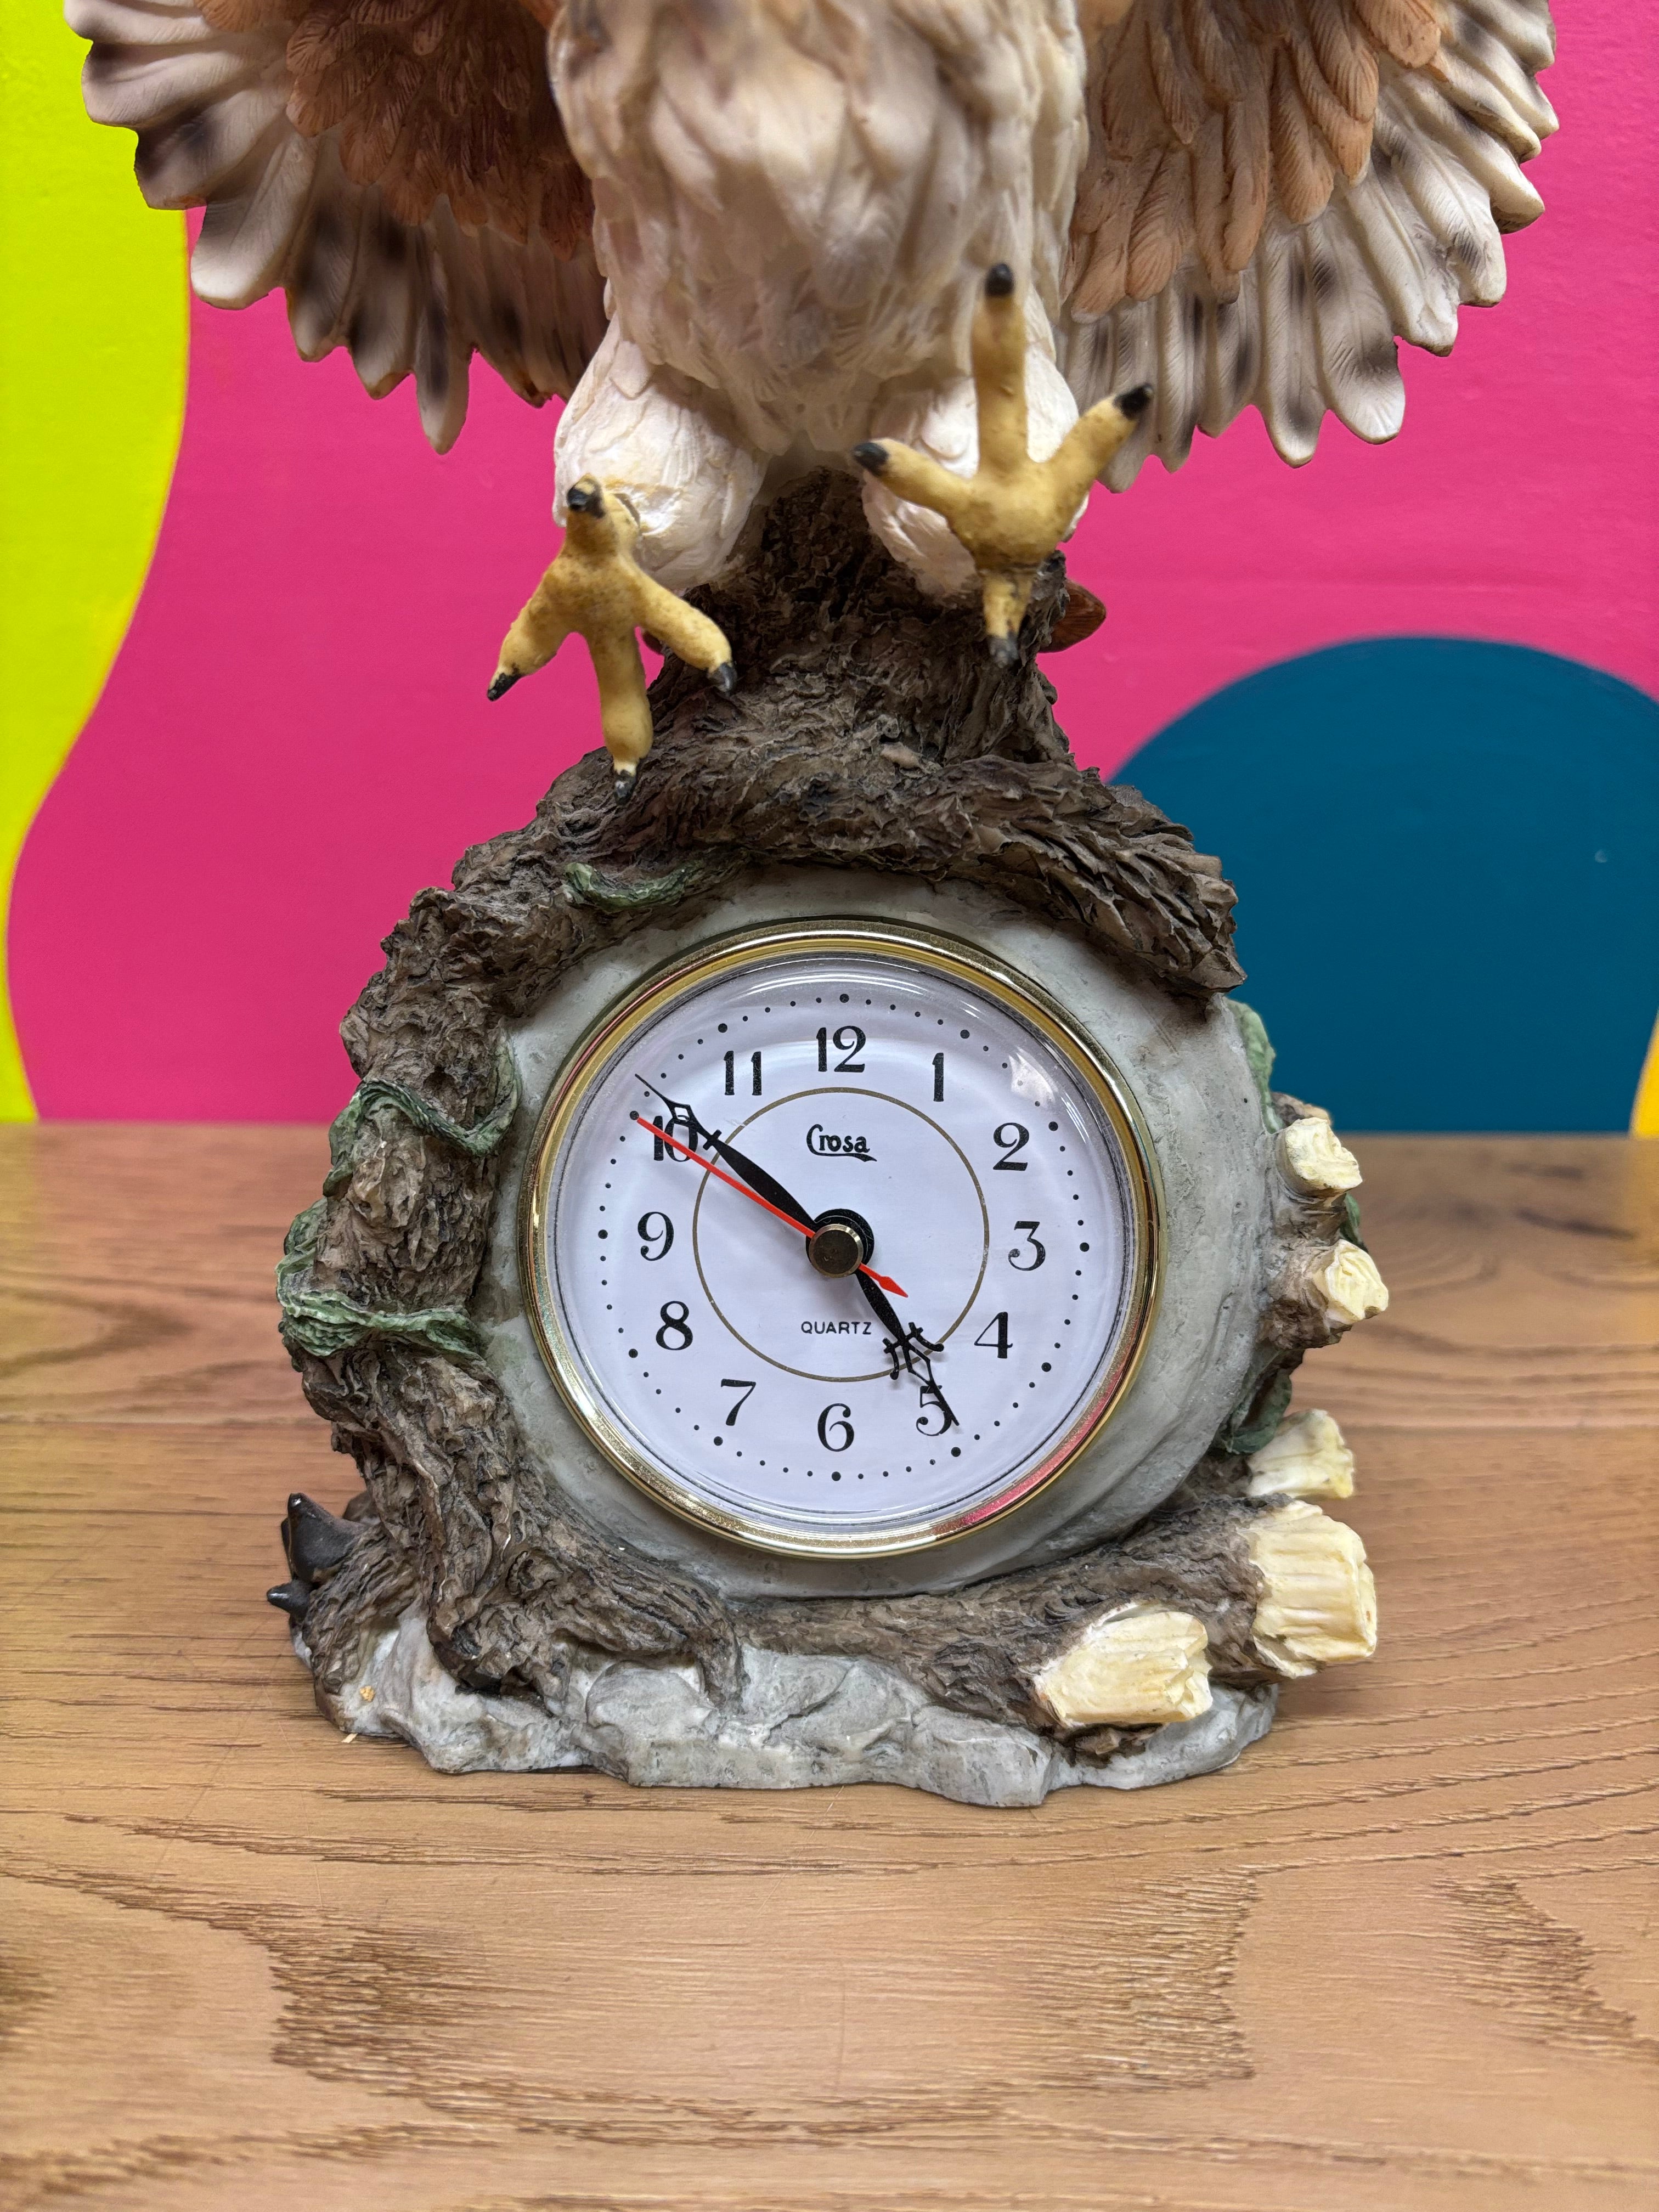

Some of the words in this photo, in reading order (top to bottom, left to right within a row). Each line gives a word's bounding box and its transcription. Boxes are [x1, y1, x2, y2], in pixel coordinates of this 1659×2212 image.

[723, 1050, 763, 1096] 11
[816, 1025, 867, 1073] 12
[932, 1052, 945, 1102] 1
[652, 1115, 698, 1162] 10
[806, 1124, 877, 1163] Crosa
[992, 1122, 1030, 1171] 2
[637, 1211, 675, 1262] 9
[1007, 1220, 1046, 1272] 3
[656, 1301, 694, 1351] 8
[801, 1321, 872, 1335] QUARTZ
[974, 1311, 1014, 1359] 4
[720, 1378, 757, 1427] 7
[916, 1385, 952, 1436] 5
[817, 1403, 855, 1453] 6
